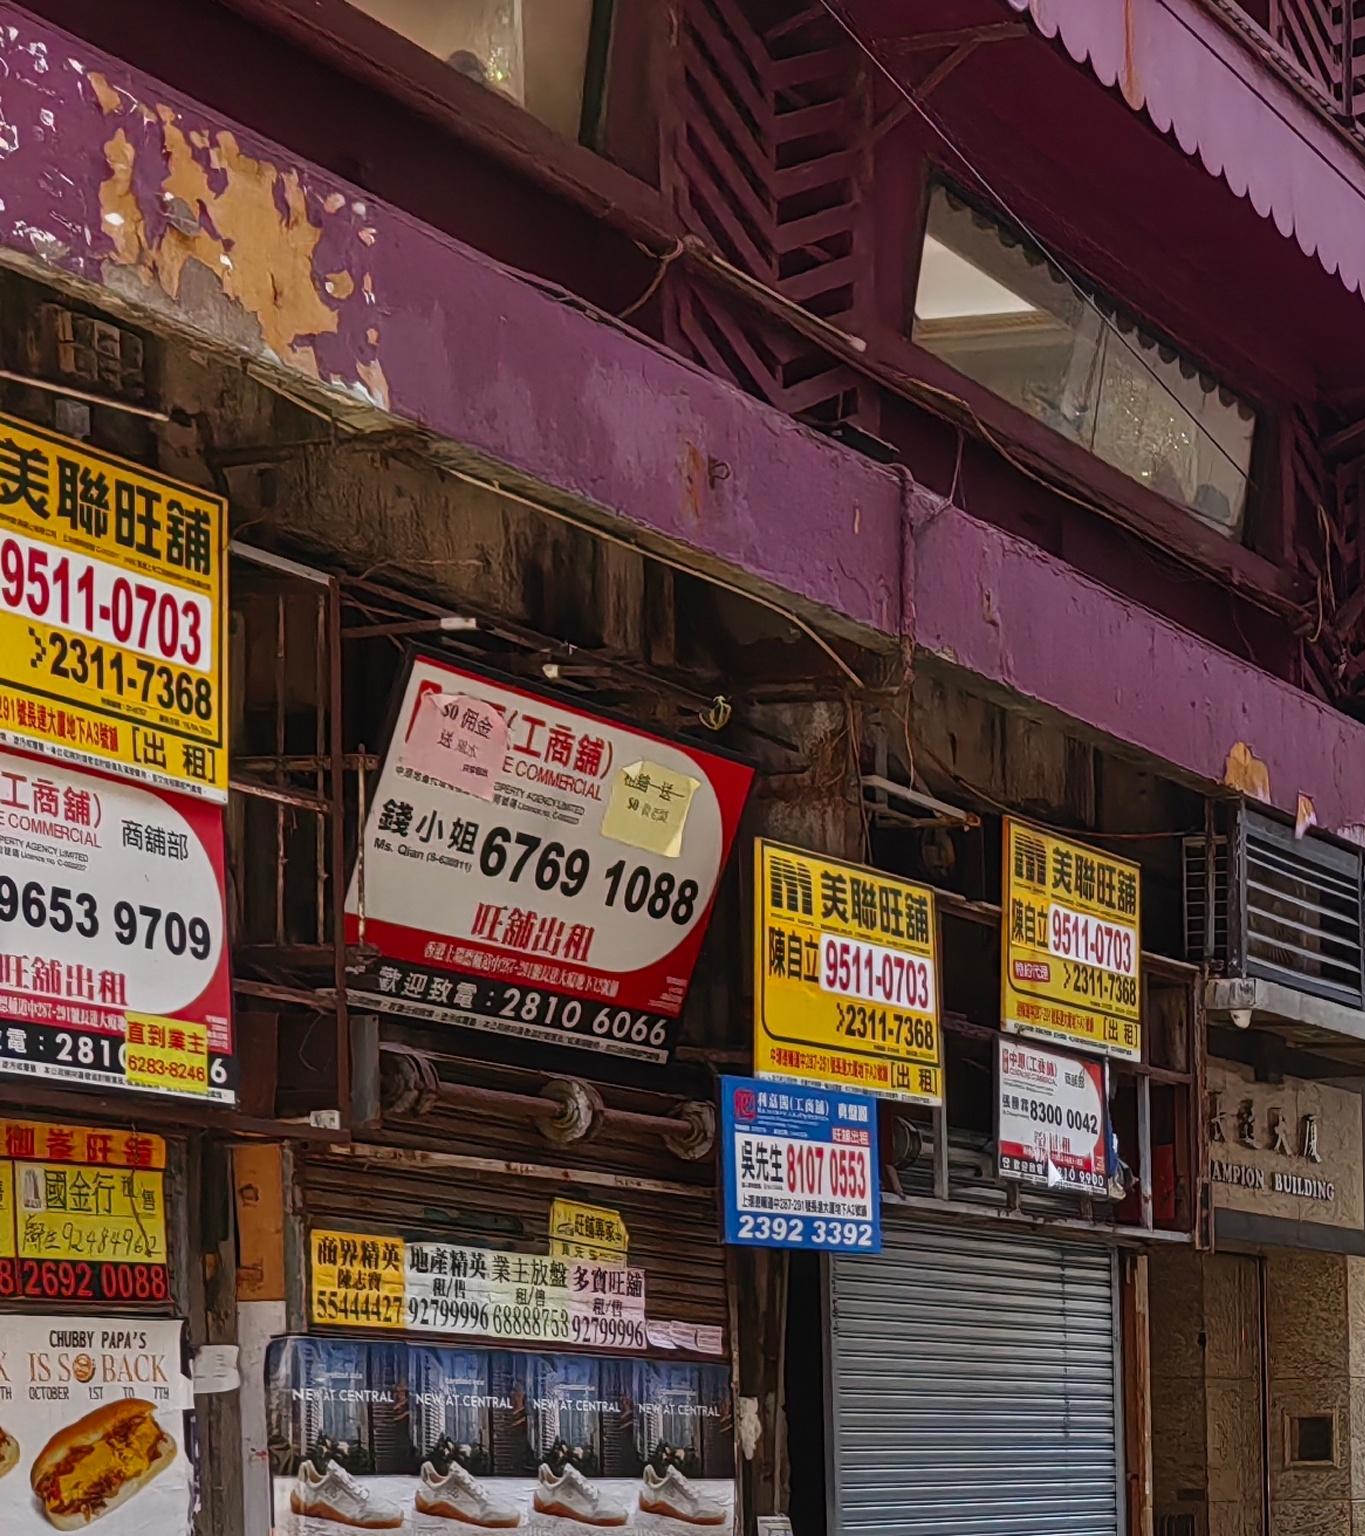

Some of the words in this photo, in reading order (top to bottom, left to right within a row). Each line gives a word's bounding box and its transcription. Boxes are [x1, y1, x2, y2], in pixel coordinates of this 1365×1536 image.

[0, 438, 210, 576] 美聯旺舖
[1, 538, 202, 665] 9511-0703
[49, 632, 212, 720] 2311-7368
[517, 759, 602, 800] COMMERCIAL
[8, 813, 102, 848] COMMERCIAL
[379, 798, 480, 855] 錢小姐
[480, 826, 590, 898] 6769
[604, 860, 699, 925] 1088
[1052, 847, 1136, 916] 美聯旺舖
[0, 875, 99, 938] 9653
[114, 901, 211, 960] 9709
[820, 870, 929, 944] 美聯旺舖
[471, 903, 596, 962] 旺舖出租
[1053, 909, 1132, 973] 9511-0703
[768, 926, 819, 983] 陳自立
[825, 939, 929, 1008] 9511-0703
[1074, 965, 1136, 1006] 2311-7368
[499, 988, 582, 1028] 2810
[592, 1007, 668, 1046] 6066
[845, 1005, 934, 1051] 2311-7368
[1030, 1100, 1062, 1126] 8300
[1066, 1108, 1098, 1134] 0042
[741, 1141, 784, 1183] 吳先生
[786, 1144, 824, 1194] 8107
[829, 1149, 866, 1199] 0553
[1211, 1160, 1264, 1190] AMPION
[1275, 1173, 1335, 1201] BUILDING
[738, 1215, 803, 1242] 2392
[811, 1220, 872, 1246] 3392
[23, 1260, 93, 1298] 2692
[102, 1263, 166, 1298] 0088
[409, 1245, 487, 1279] 地產精英
[491, 1254, 569, 1288] 業主放盤
[49, 1330, 94, 1349] CHUBBY
[101, 1331, 146, 1349] PAPA'S
[29, 1353, 51, 1383] IS
[103, 1353, 168, 1383] BACK
[29, 1386, 69, 1400] OCTOBER
[88, 1387, 104, 1400] 1ST
[123, 1386, 136, 1400] TO
[339, 1389, 394, 1403] CENTRAL
[462, 1396, 513, 1409] CENTRAL
[576, 1400, 621, 1413] CENTRAL
[678, 1404, 720, 1417] CENTRAL
